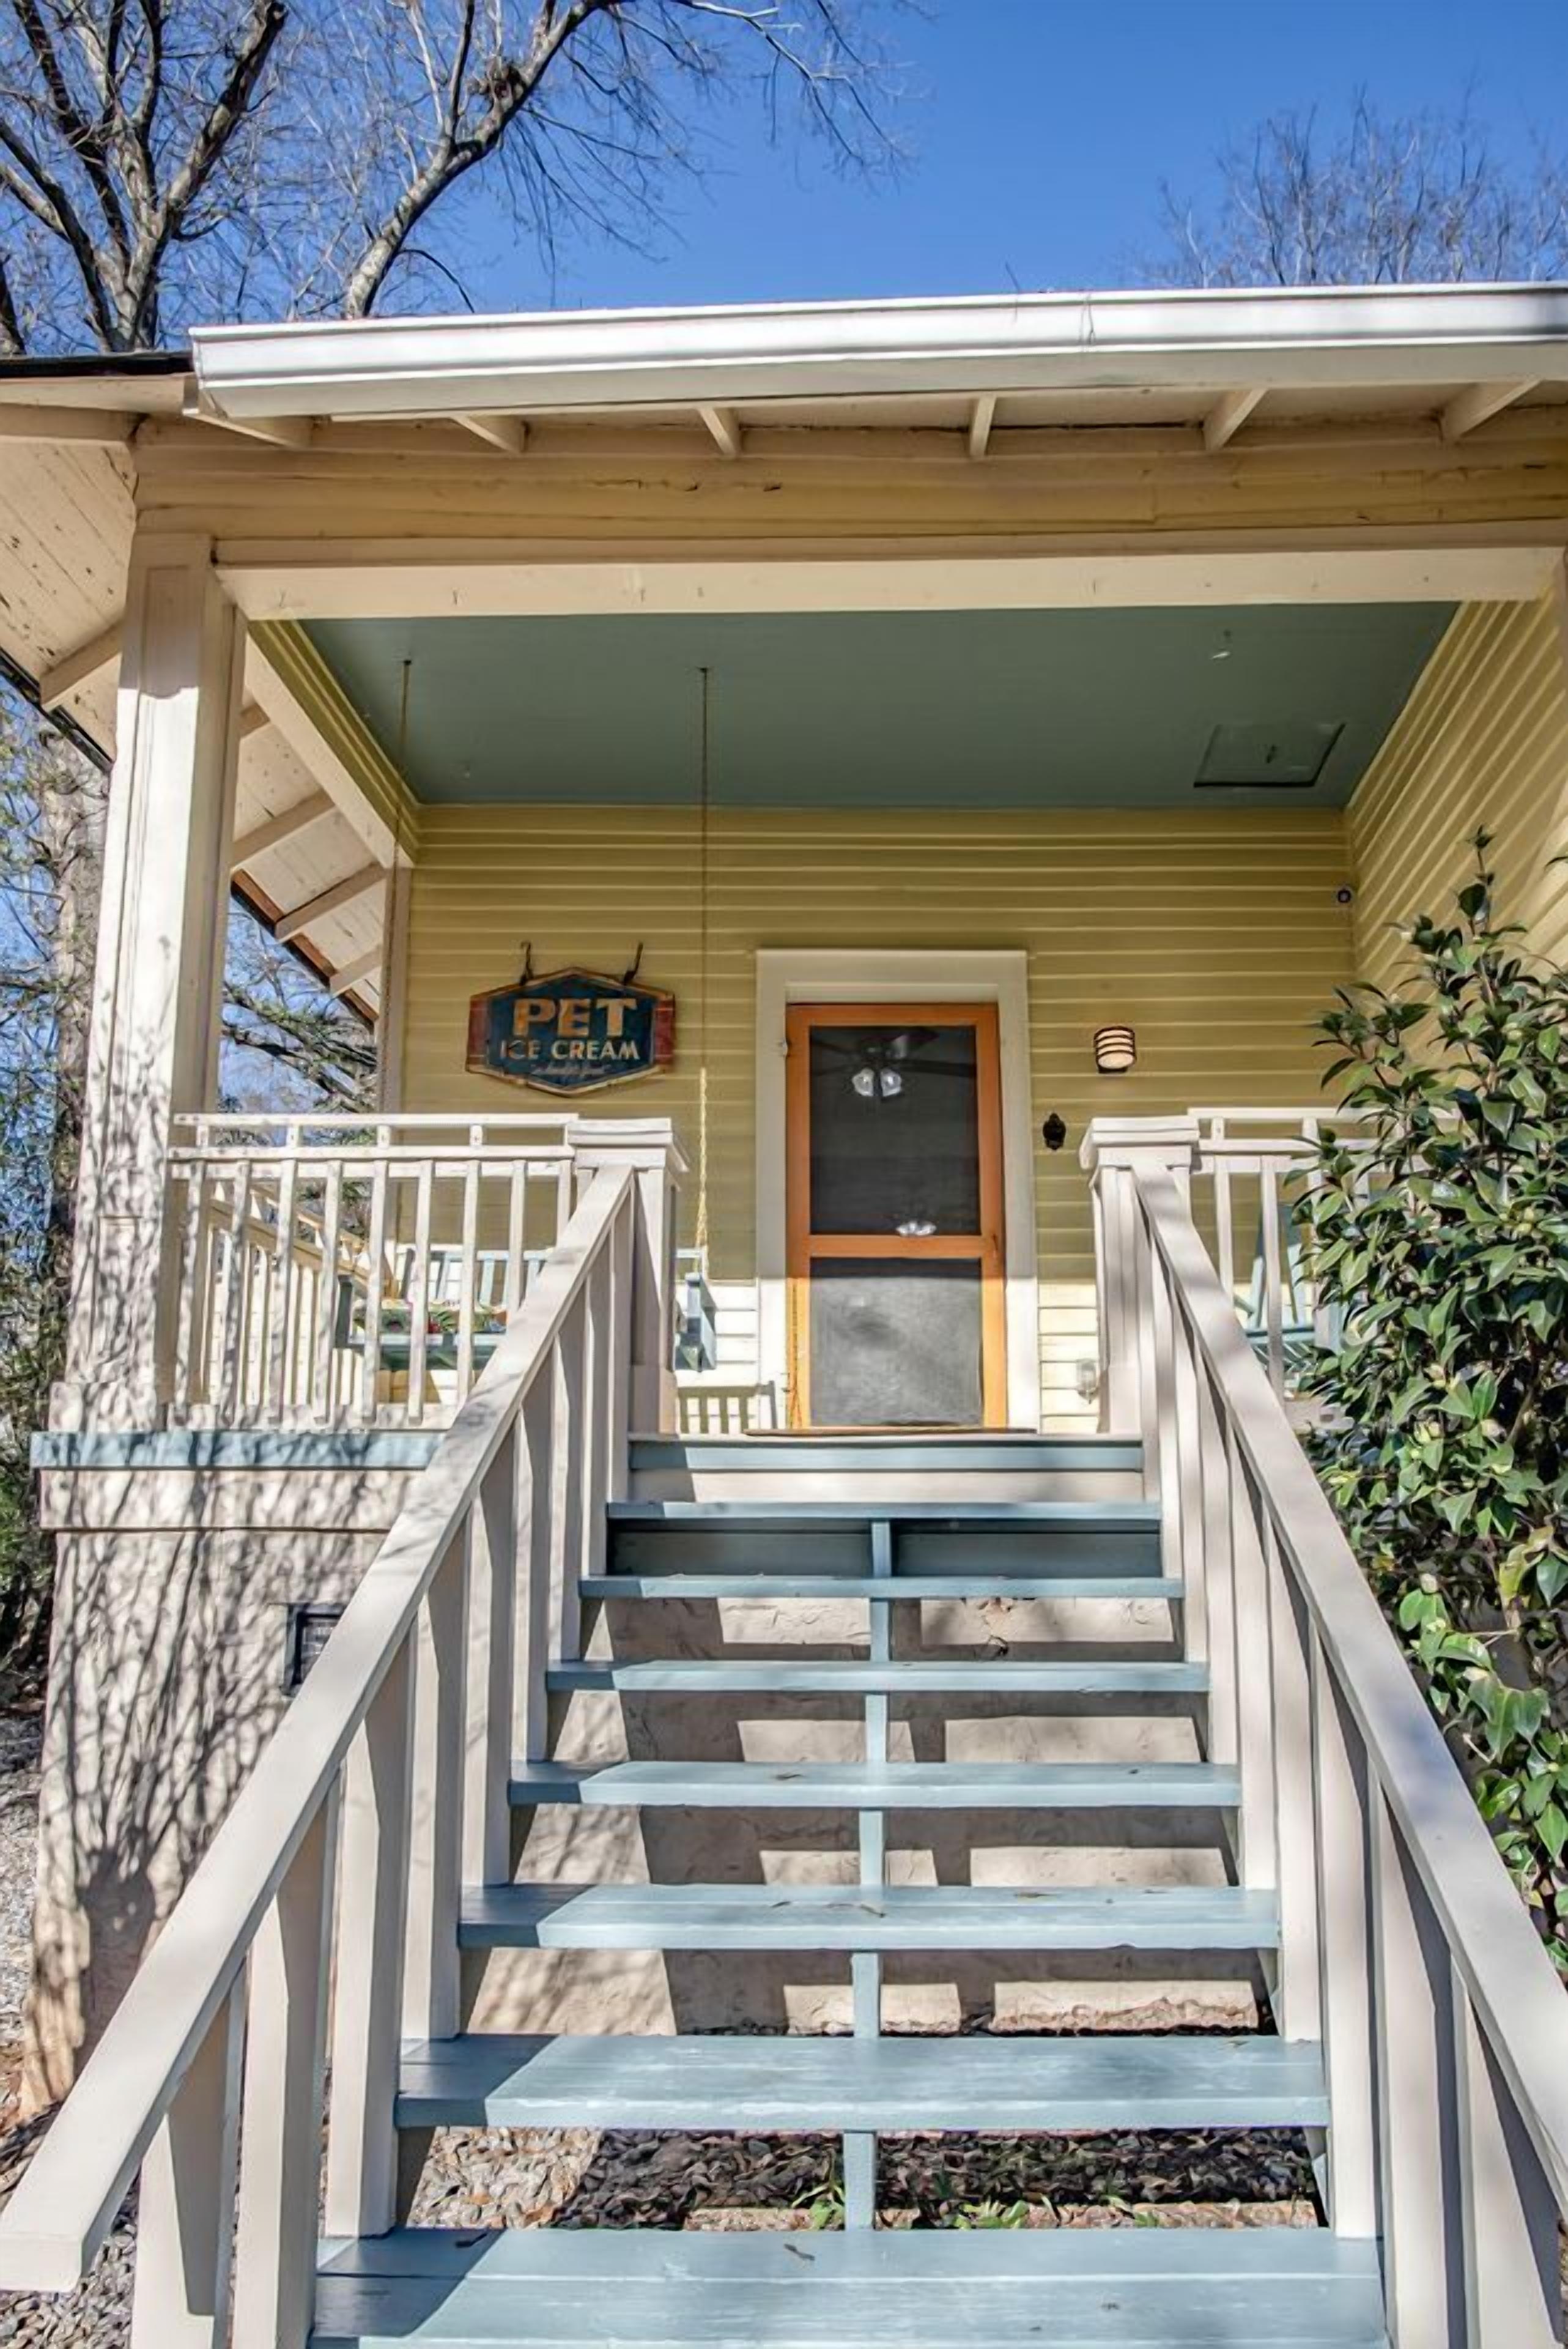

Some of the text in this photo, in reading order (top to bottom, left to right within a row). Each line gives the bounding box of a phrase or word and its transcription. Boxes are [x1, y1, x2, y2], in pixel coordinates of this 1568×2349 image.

[513, 998, 638, 1037] PET
[500, 1040, 640, 1060] ICE CREAM
